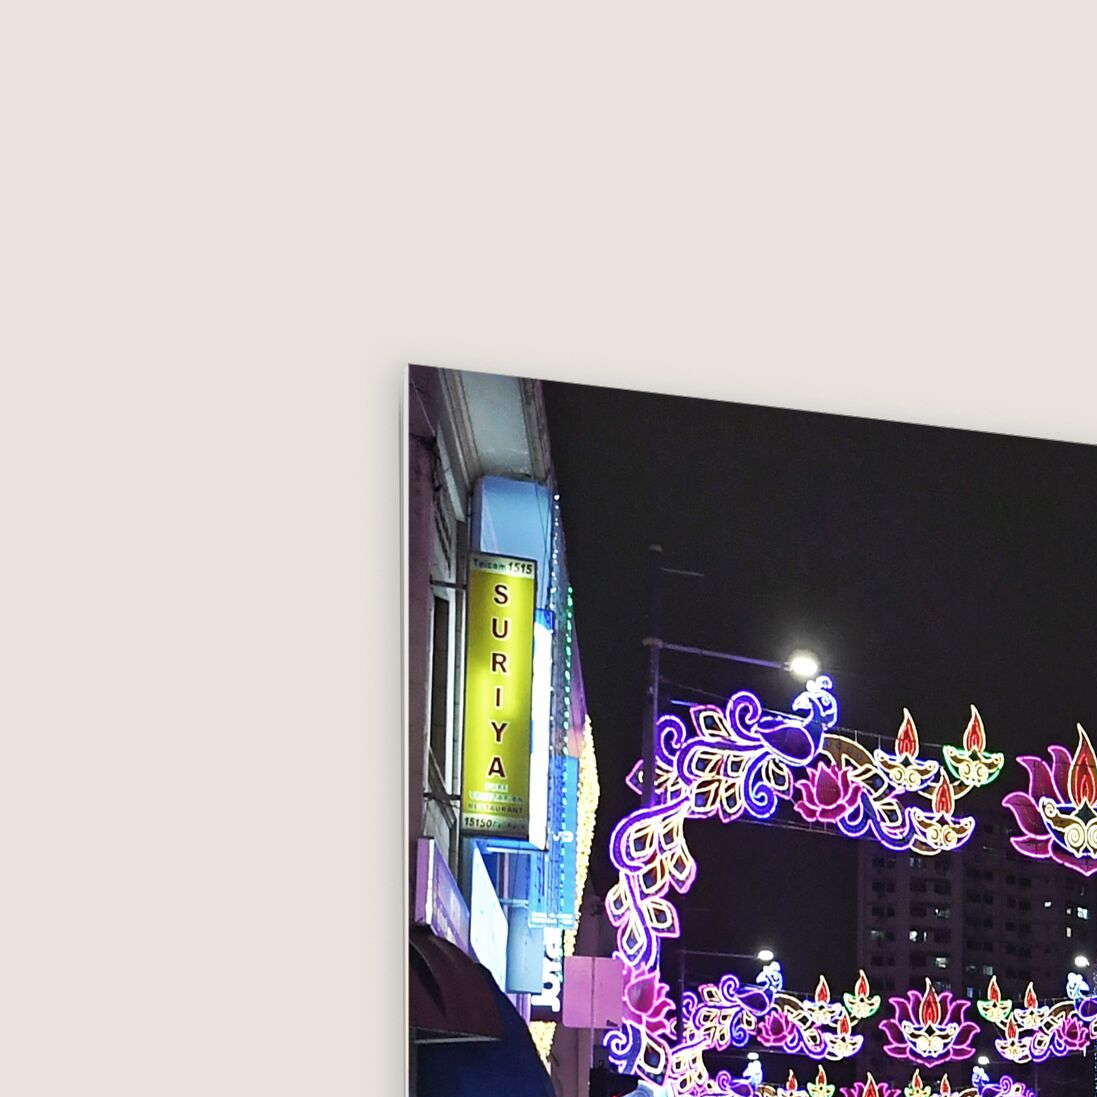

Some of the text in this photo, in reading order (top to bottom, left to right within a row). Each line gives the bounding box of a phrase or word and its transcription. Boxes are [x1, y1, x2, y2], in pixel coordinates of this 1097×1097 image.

[508, 561, 533, 575] 1515
[488, 584, 509, 777] SURIYA
[468, 803, 523, 814] RESTAURANT
